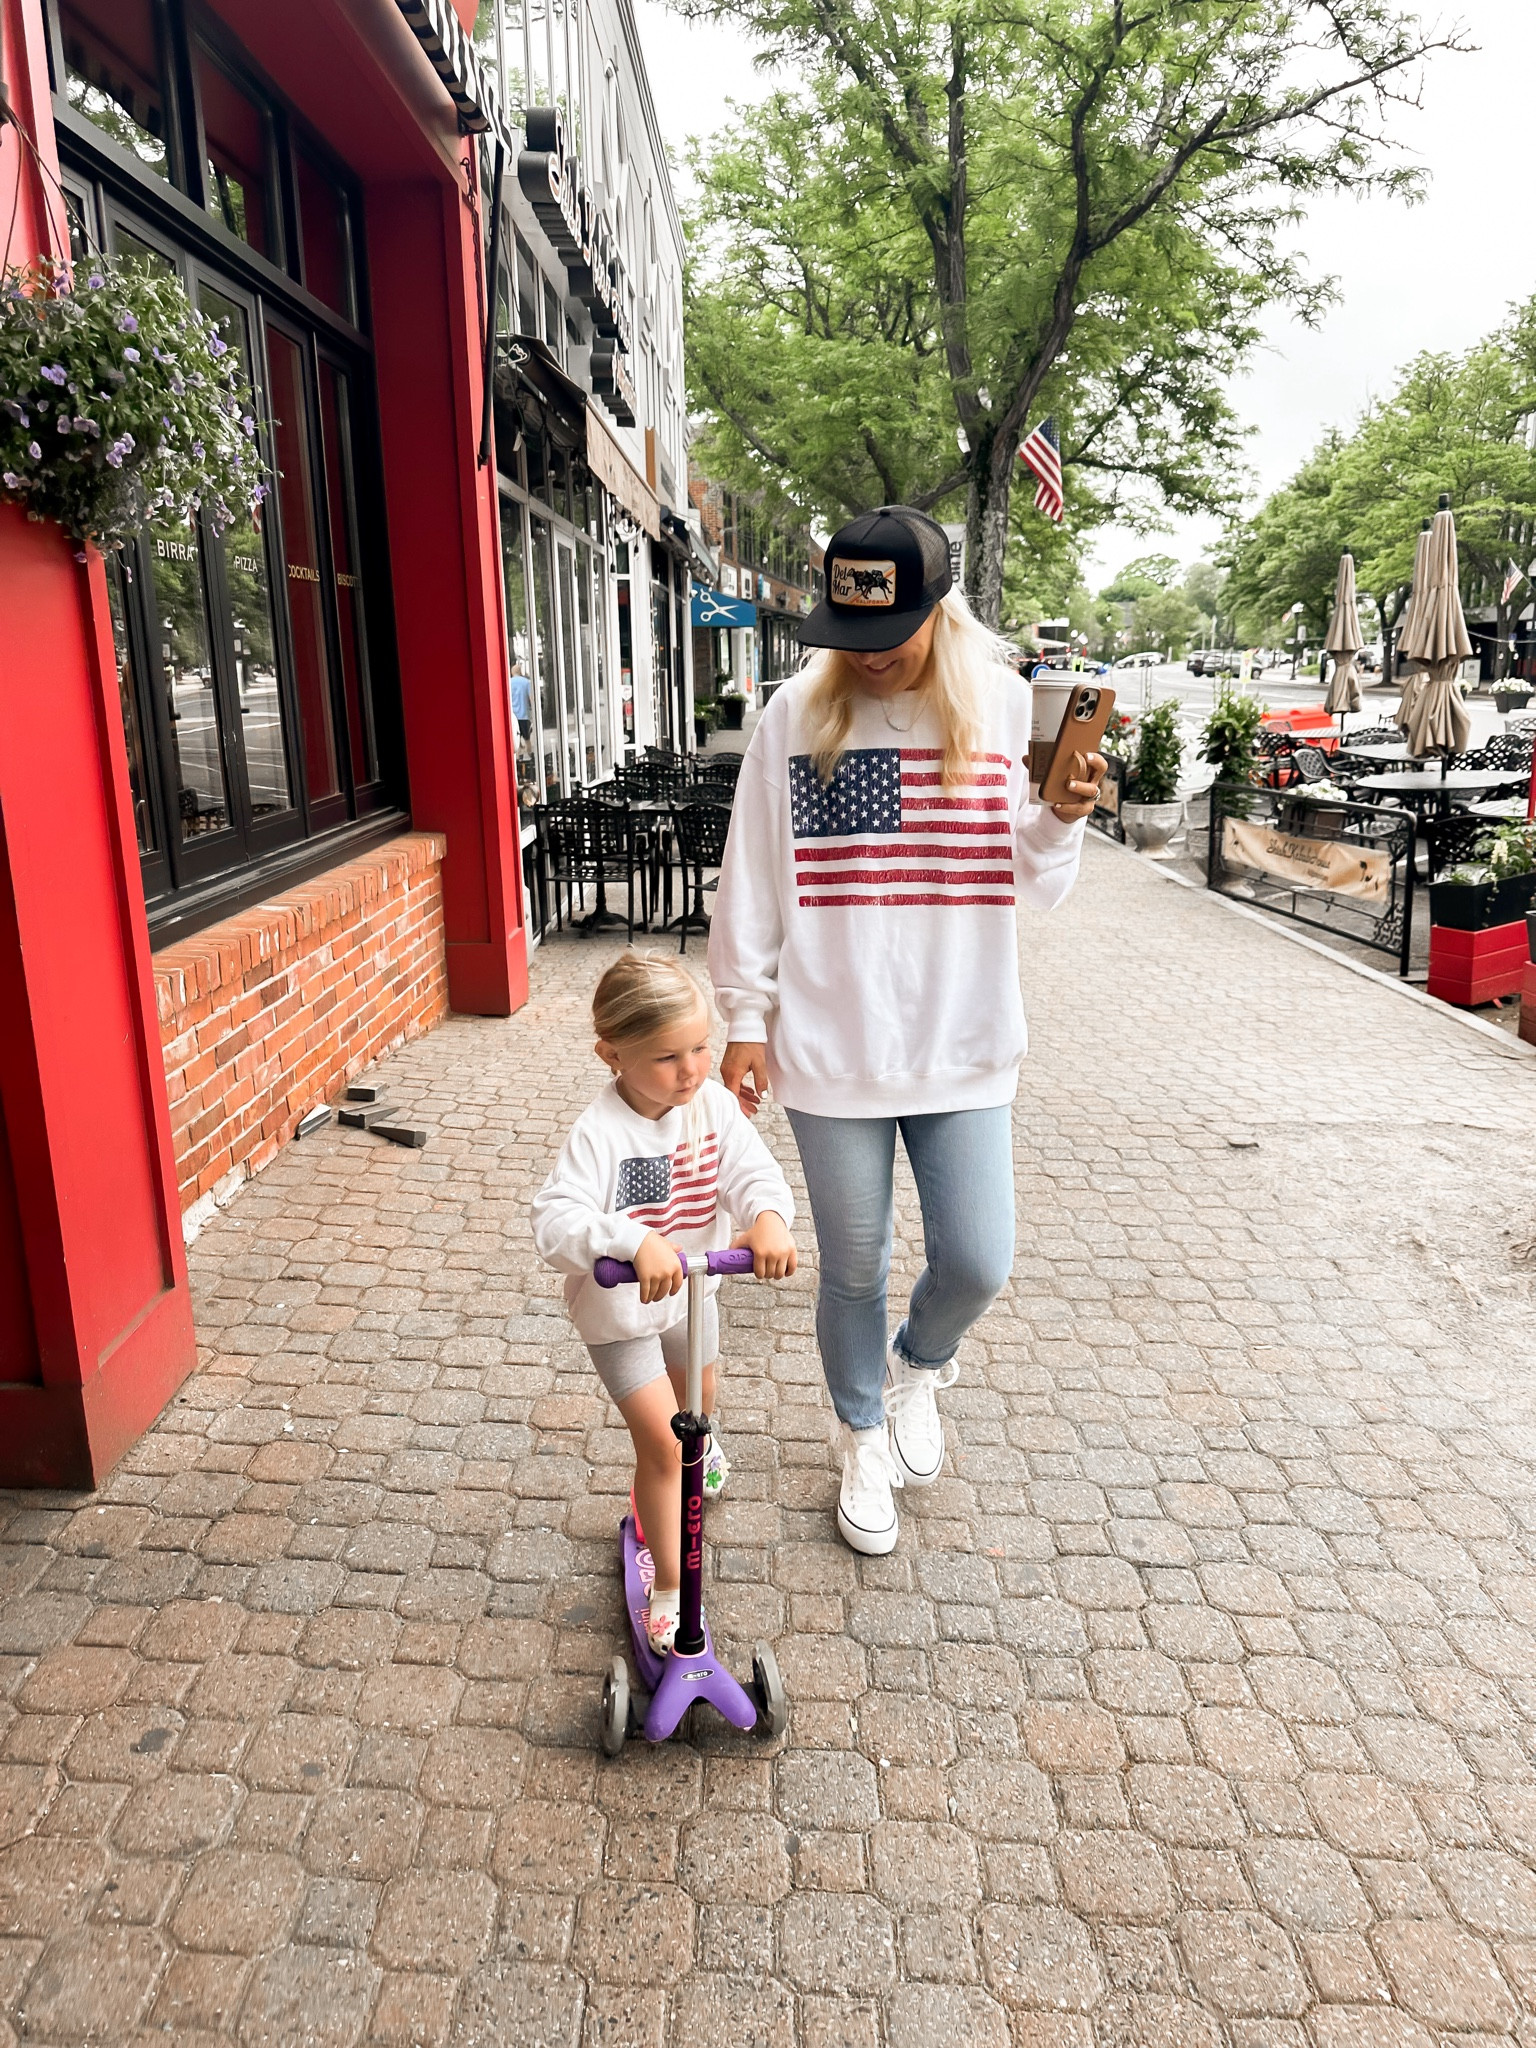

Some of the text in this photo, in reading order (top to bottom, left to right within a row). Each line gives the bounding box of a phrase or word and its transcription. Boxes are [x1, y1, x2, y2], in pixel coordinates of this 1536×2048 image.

[157, 539, 194, 562] BIRRA
[235, 556, 259, 573] PIZZA
[834, 564, 848, 581] Del
[833, 579, 852, 596] Mar
